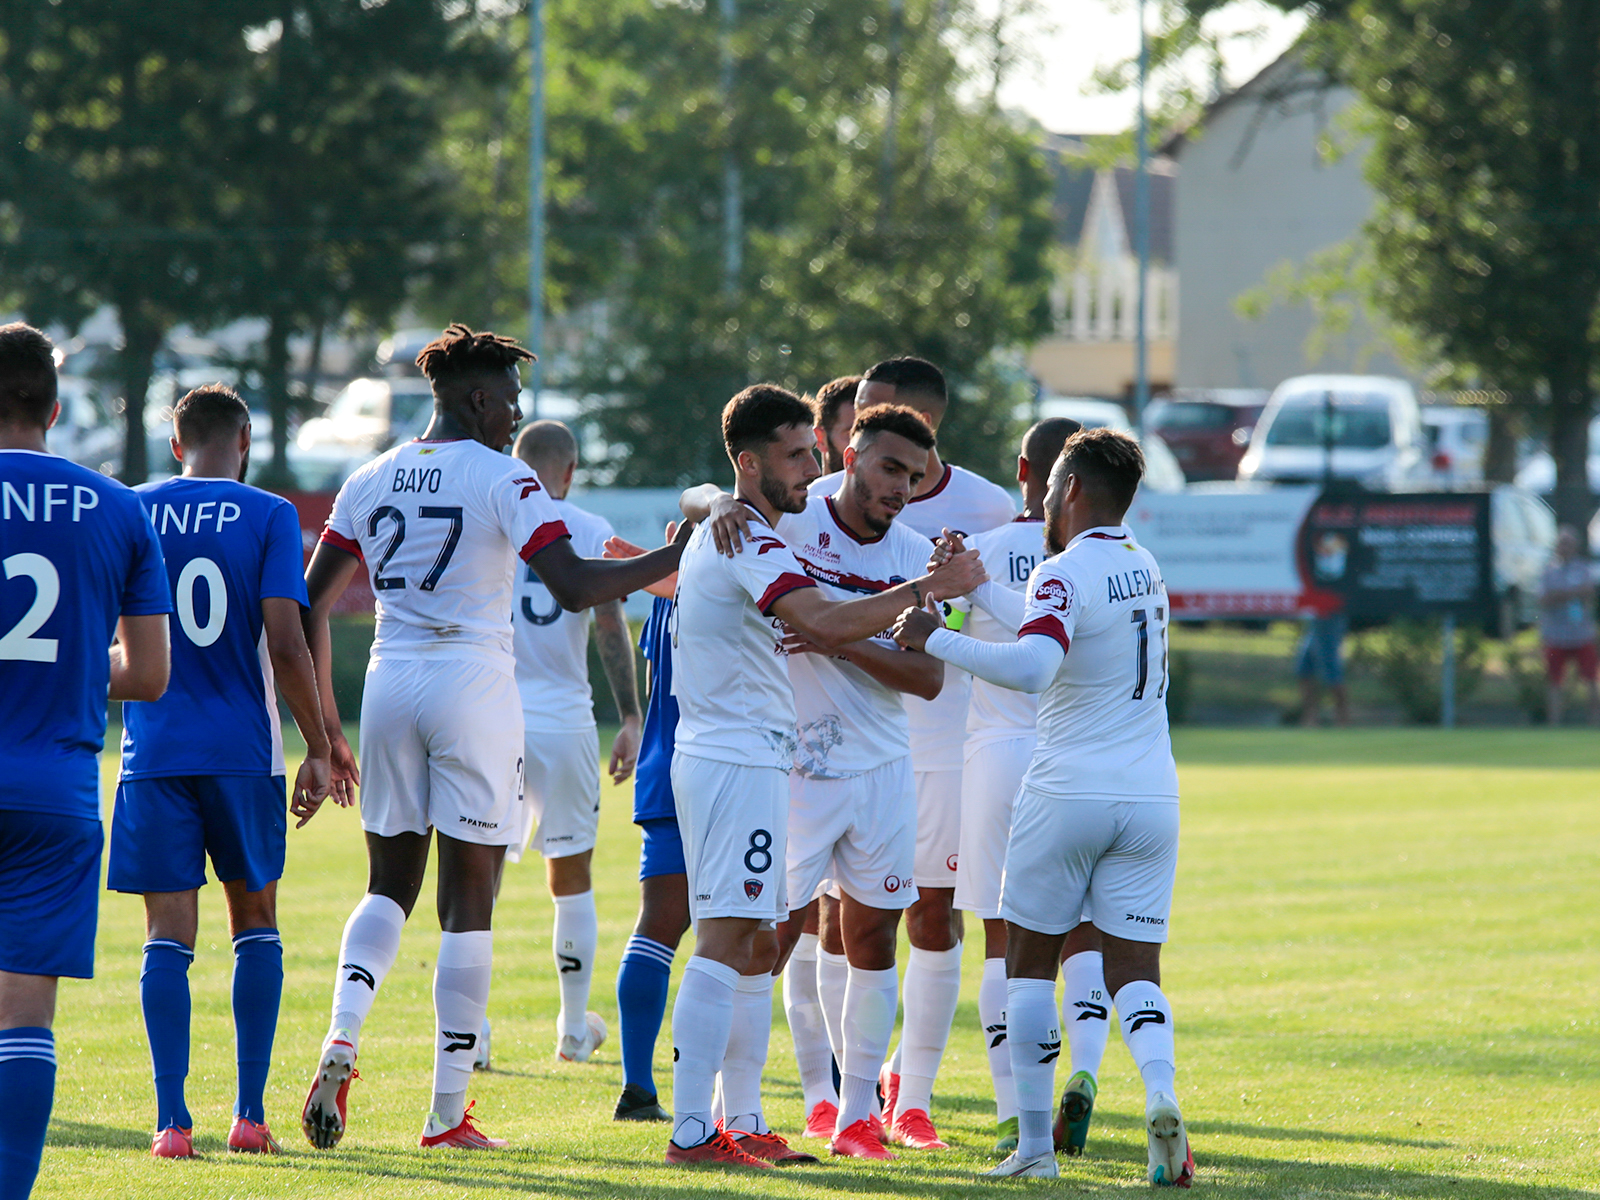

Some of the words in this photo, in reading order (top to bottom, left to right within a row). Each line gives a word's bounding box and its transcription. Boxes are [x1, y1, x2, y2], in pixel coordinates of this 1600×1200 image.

[392, 468, 442, 494] BAYO
[367, 505, 463, 592] 27
[806, 564, 841, 584] PATRICK
[1037, 585, 1067, 599] SCOOP
[0, 552, 60, 663] 2
[163, 557, 228, 648] 0
[467, 818, 499, 829] PATRICK
[743, 828, 773, 874] 8
[1135, 915, 1165, 926] PATRICK
[1090, 990, 1102, 1001] 10
[1144, 1000, 1155, 1008] 11
[1049, 1029, 1058, 1040] 11
